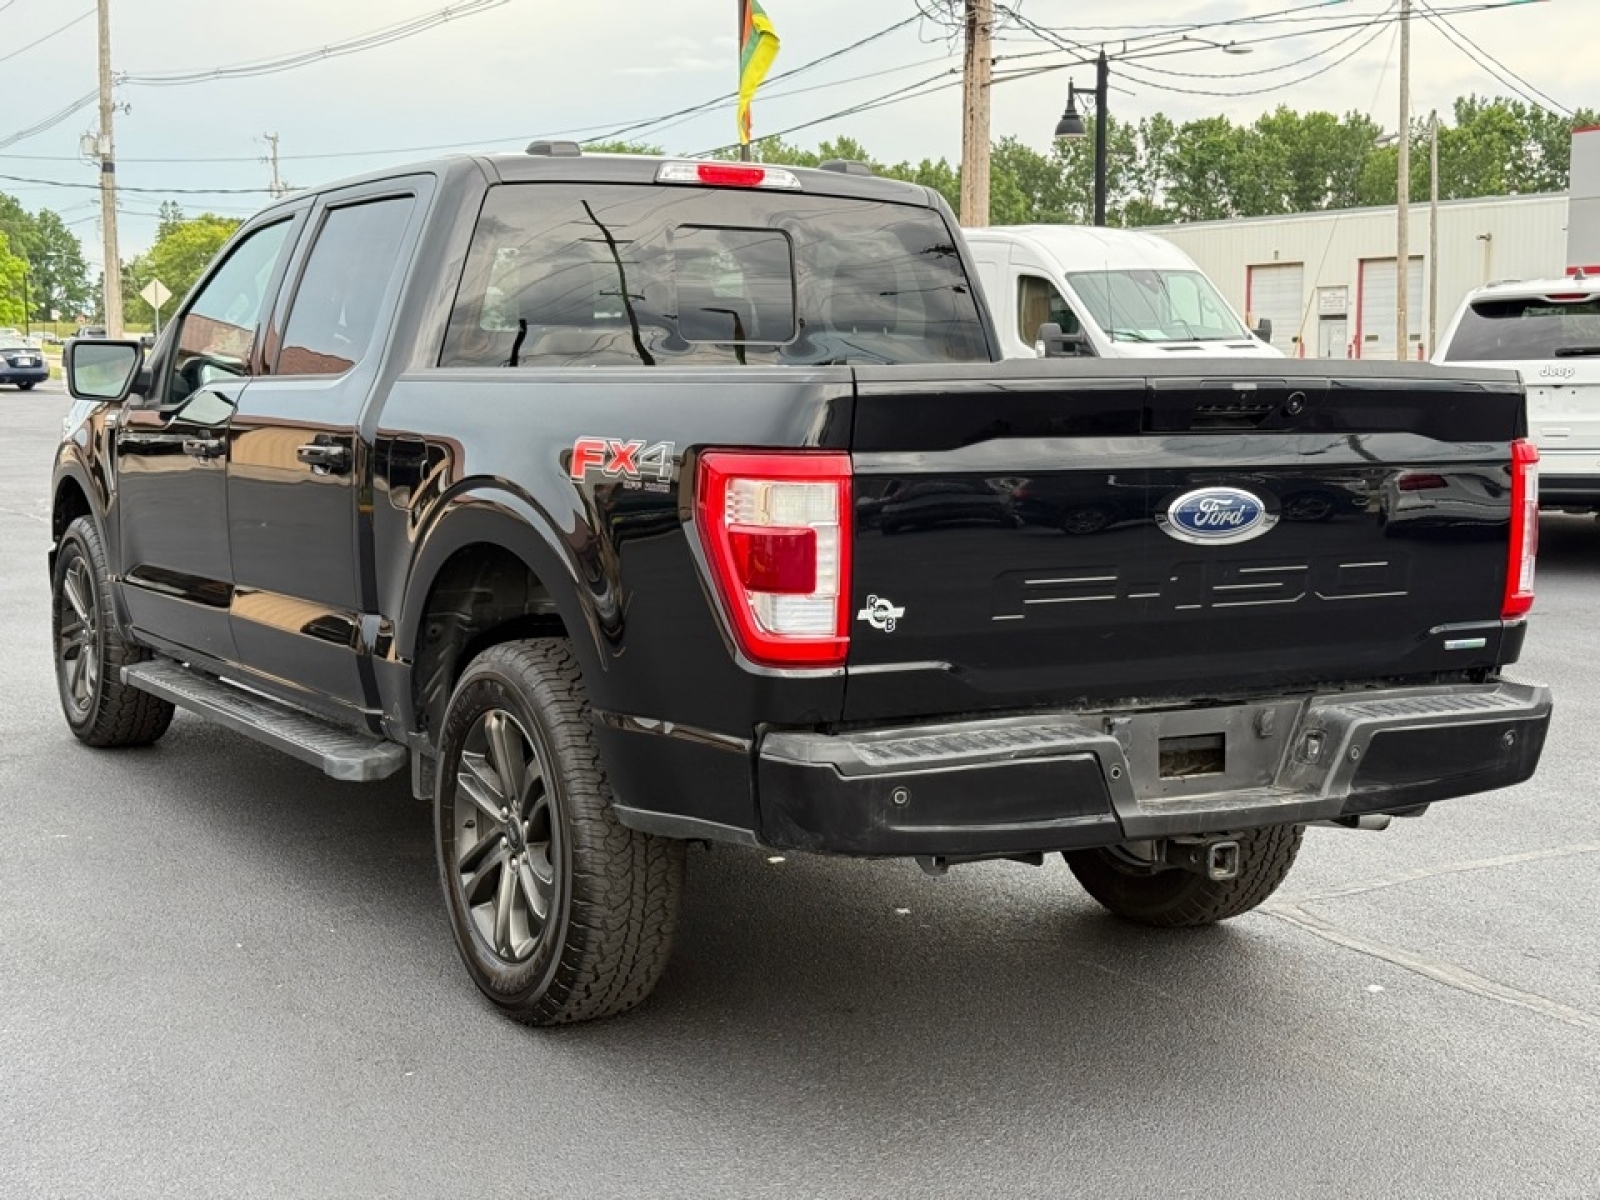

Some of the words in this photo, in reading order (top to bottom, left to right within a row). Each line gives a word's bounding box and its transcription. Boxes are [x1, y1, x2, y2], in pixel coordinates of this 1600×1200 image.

[570, 436, 675, 483] FX4
[1194, 498, 1246, 525] Ford
[991, 553, 1410, 620] F-150
